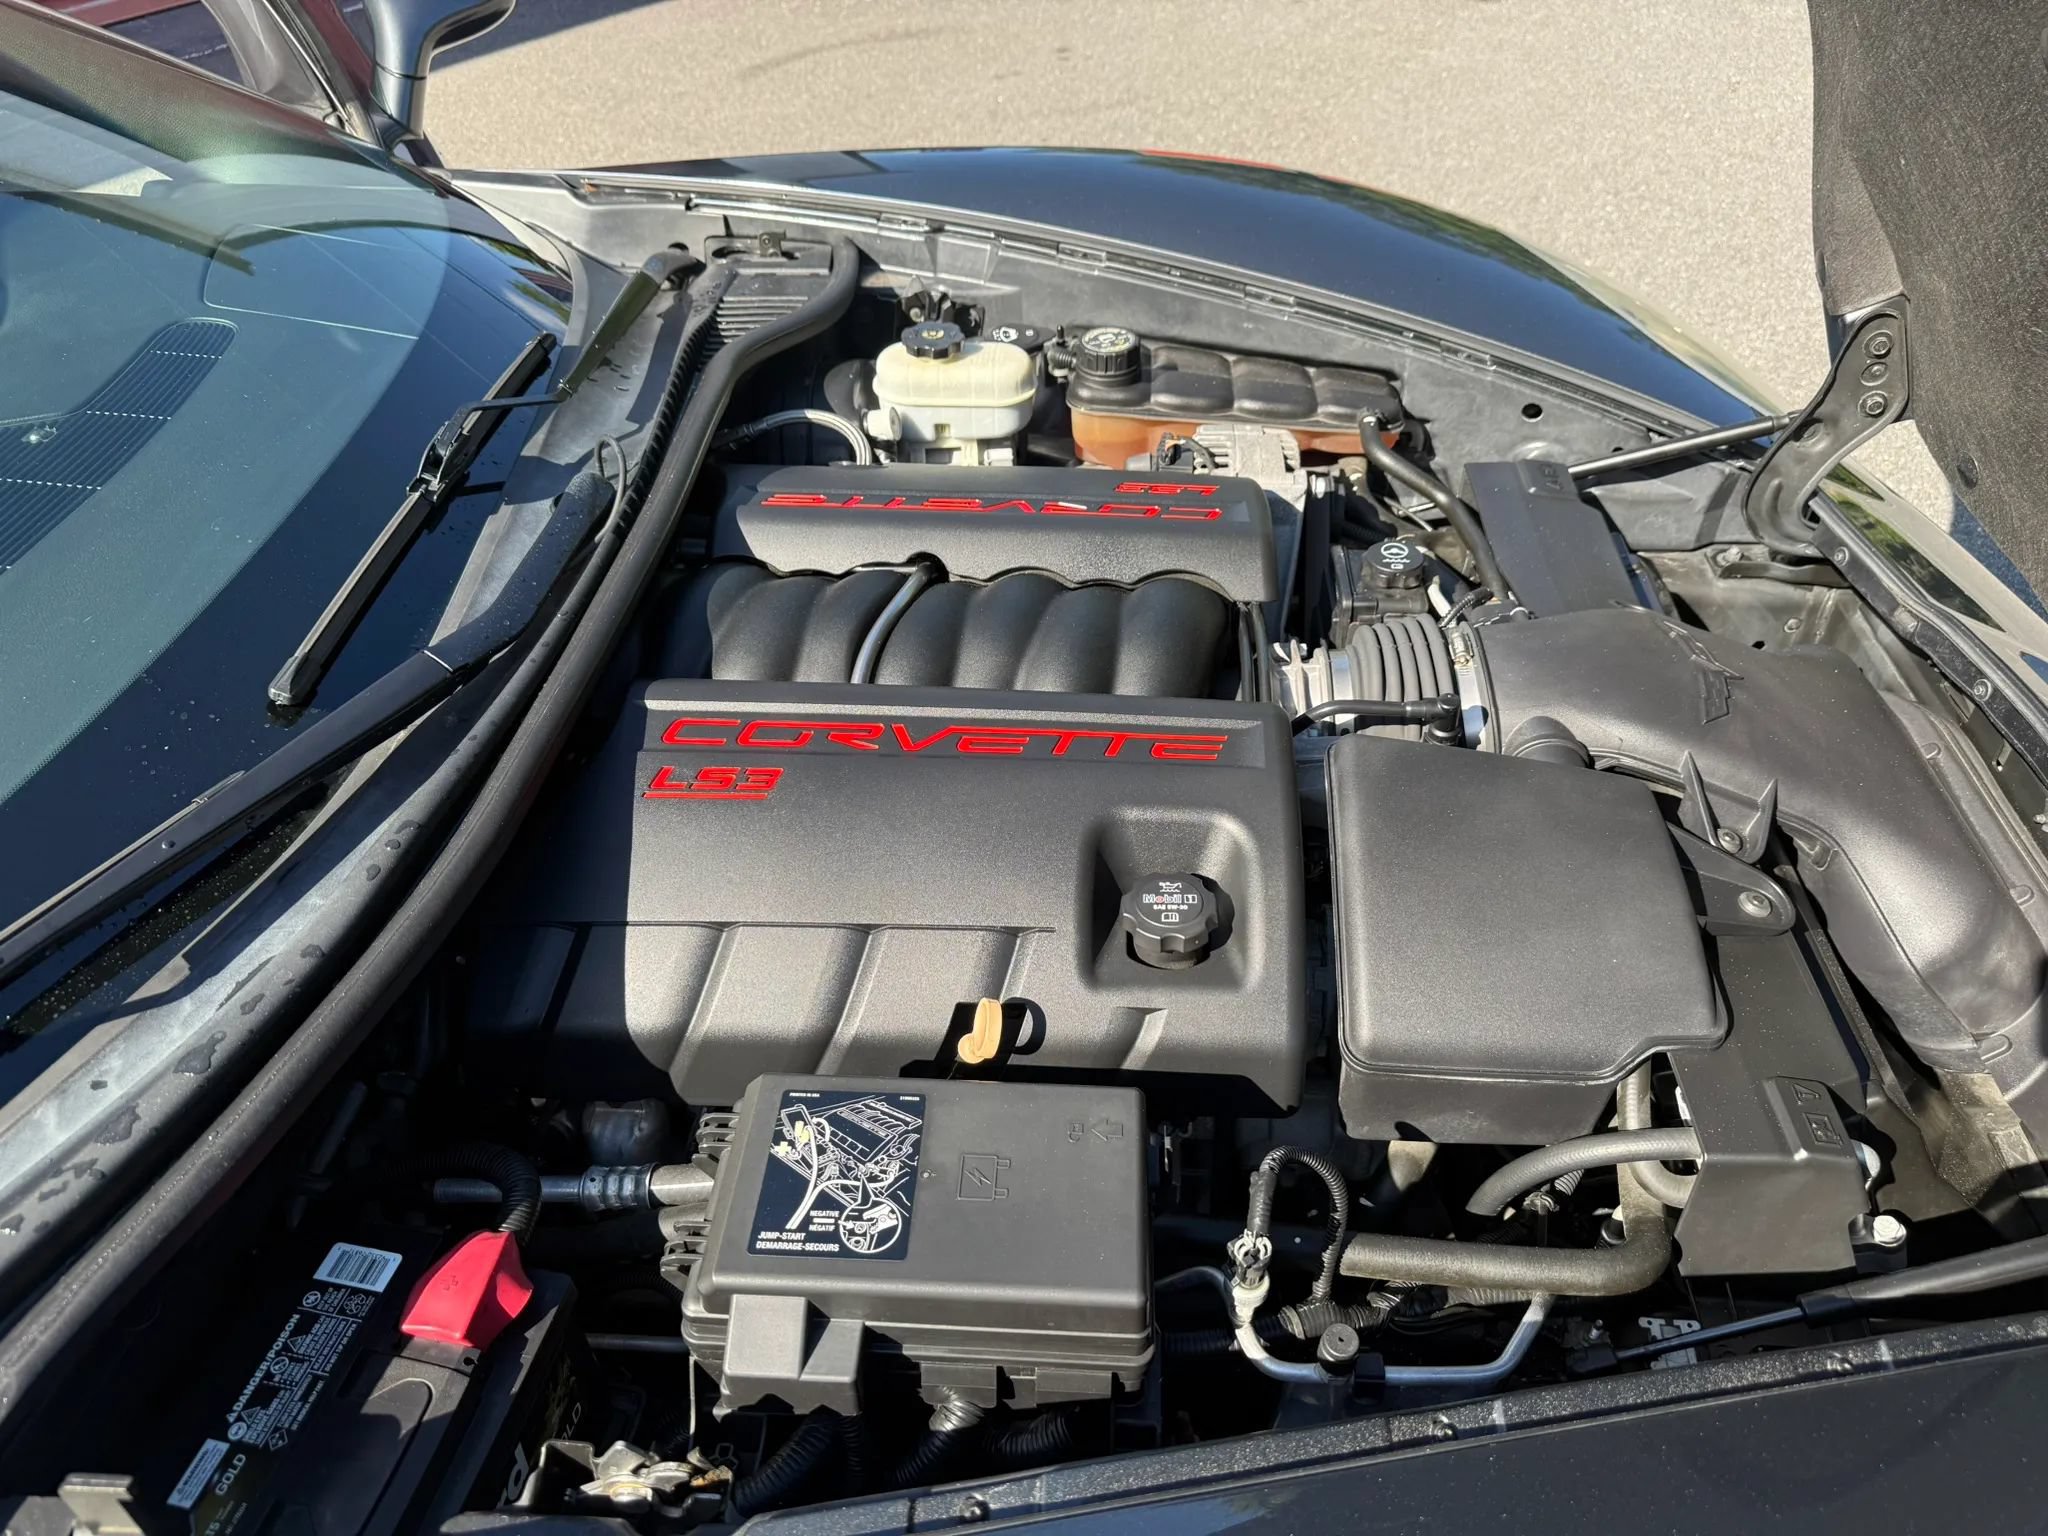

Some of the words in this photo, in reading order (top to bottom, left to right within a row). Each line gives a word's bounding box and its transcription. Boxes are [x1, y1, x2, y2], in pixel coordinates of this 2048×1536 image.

[761, 494, 1222, 521] CORVETTE
[660, 717, 1228, 761] CORVETTE
[646, 766, 784, 794] LS3
[1142, 894, 1182, 903] Mobil
[758, 1232, 806, 1241] JUMP-START
[809, 1223, 836, 1232] NÉGATIF
[756, 1241, 840, 1252] DEMARRAGE-SECOURS
[234, 1313, 301, 1413] DANGER/POISON
[215, 1453, 247, 1496] GOLD
